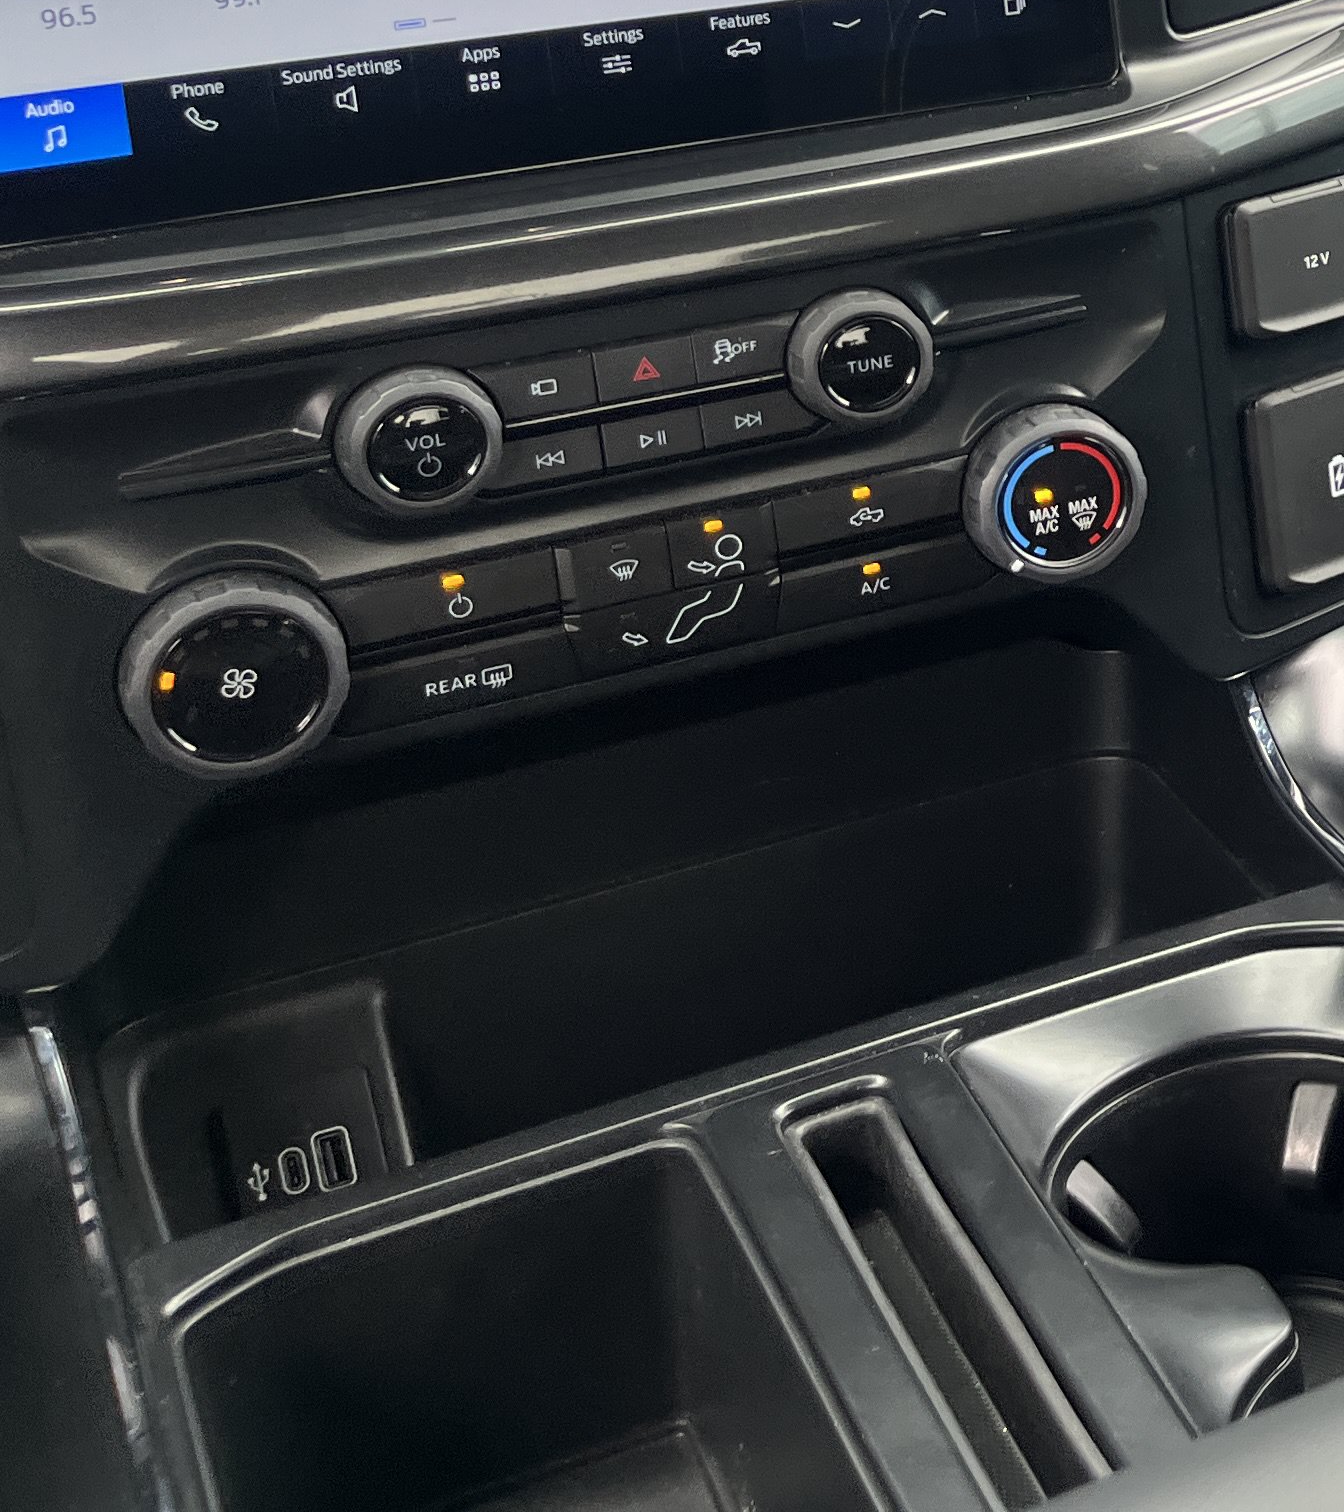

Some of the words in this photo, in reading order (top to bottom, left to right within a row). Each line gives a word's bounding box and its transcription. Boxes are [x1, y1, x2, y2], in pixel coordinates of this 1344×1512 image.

[40, 4, 97, 31] 96.5
[709, 10, 771, 32] Features
[582, 25, 644, 50] Settings
[461, 44, 501, 65] Apps
[281, 63, 333, 87] Sound
[336, 56, 402, 80] Settings
[171, 79, 225, 100] Phone
[25, 98, 75, 119] Audio
[732, 338, 758, 354] OFF
[847, 355, 895, 375] TUNE
[405, 433, 446, 453] VOL
[1029, 505, 1060, 523] MAX
[1068, 496, 1099, 514] MAX
[1035, 519, 1059, 536] A/C
[860, 576, 891, 596] A/C
[425, 674, 478, 698] REAR
